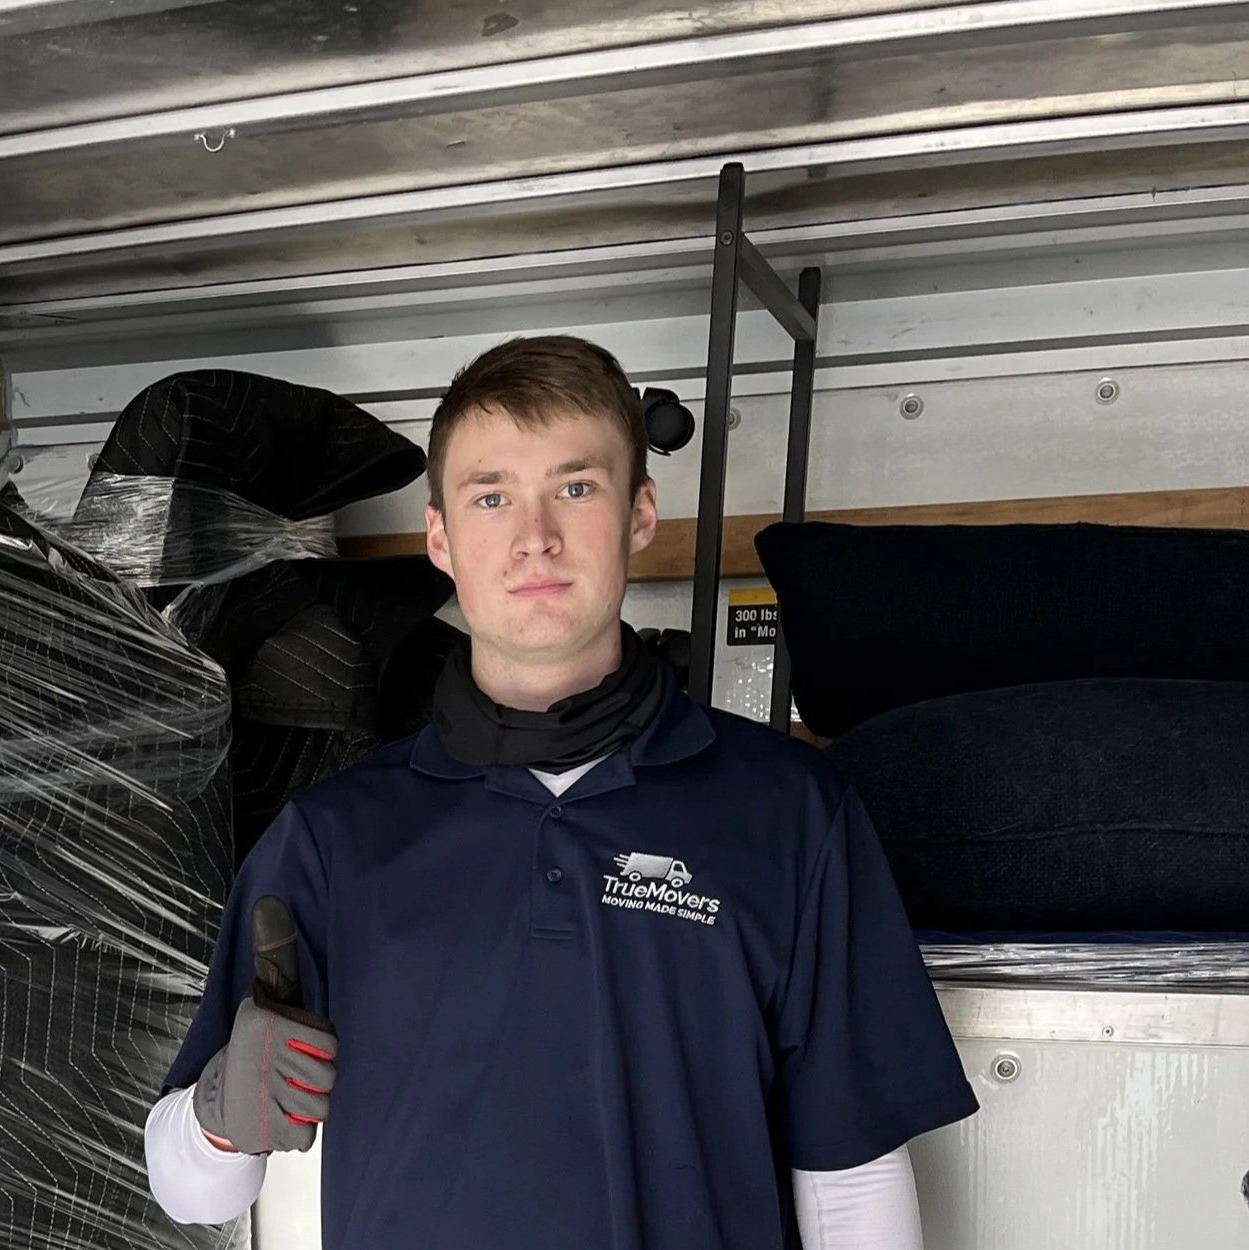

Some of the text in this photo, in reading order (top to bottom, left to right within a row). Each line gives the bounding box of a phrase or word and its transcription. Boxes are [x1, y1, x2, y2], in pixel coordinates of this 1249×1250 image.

[735, 608, 778, 622] 300 lbs
[734, 626, 746, 639] in
[603, 874, 721, 913] TrueMovers
[601, 894, 716, 926] MOVING MADE SIMPLE
